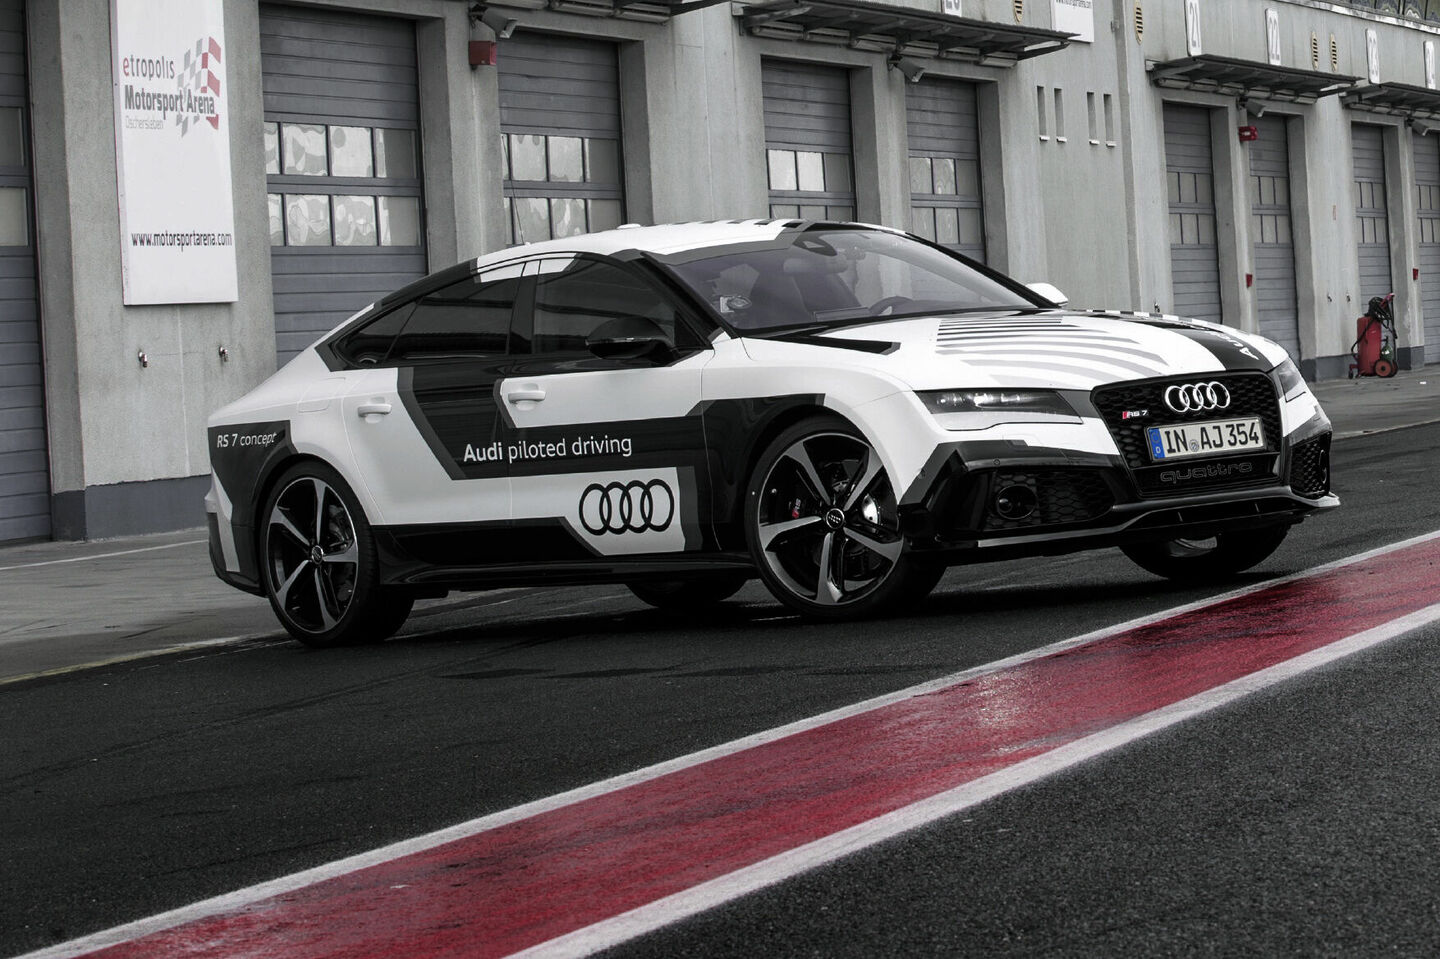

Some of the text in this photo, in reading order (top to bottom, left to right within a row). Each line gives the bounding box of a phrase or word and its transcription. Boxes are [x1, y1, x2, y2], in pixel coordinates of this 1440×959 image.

[1189, 1, 1200, 48] 21
[1269, 16, 1280, 61] 22
[123, 54, 176, 81] etropolis
[125, 85, 215, 120] Motorsport Arena
[131, 229, 233, 253] www.motorsportarena.com
[1126, 410, 1140, 419] RS
[217, 432, 277, 448] RS 7 concept
[464, 434, 632, 464] Audi piloted driving
[1164, 422, 1260, 454] IN AJ 354
[1160, 462, 1253, 484] quattro
